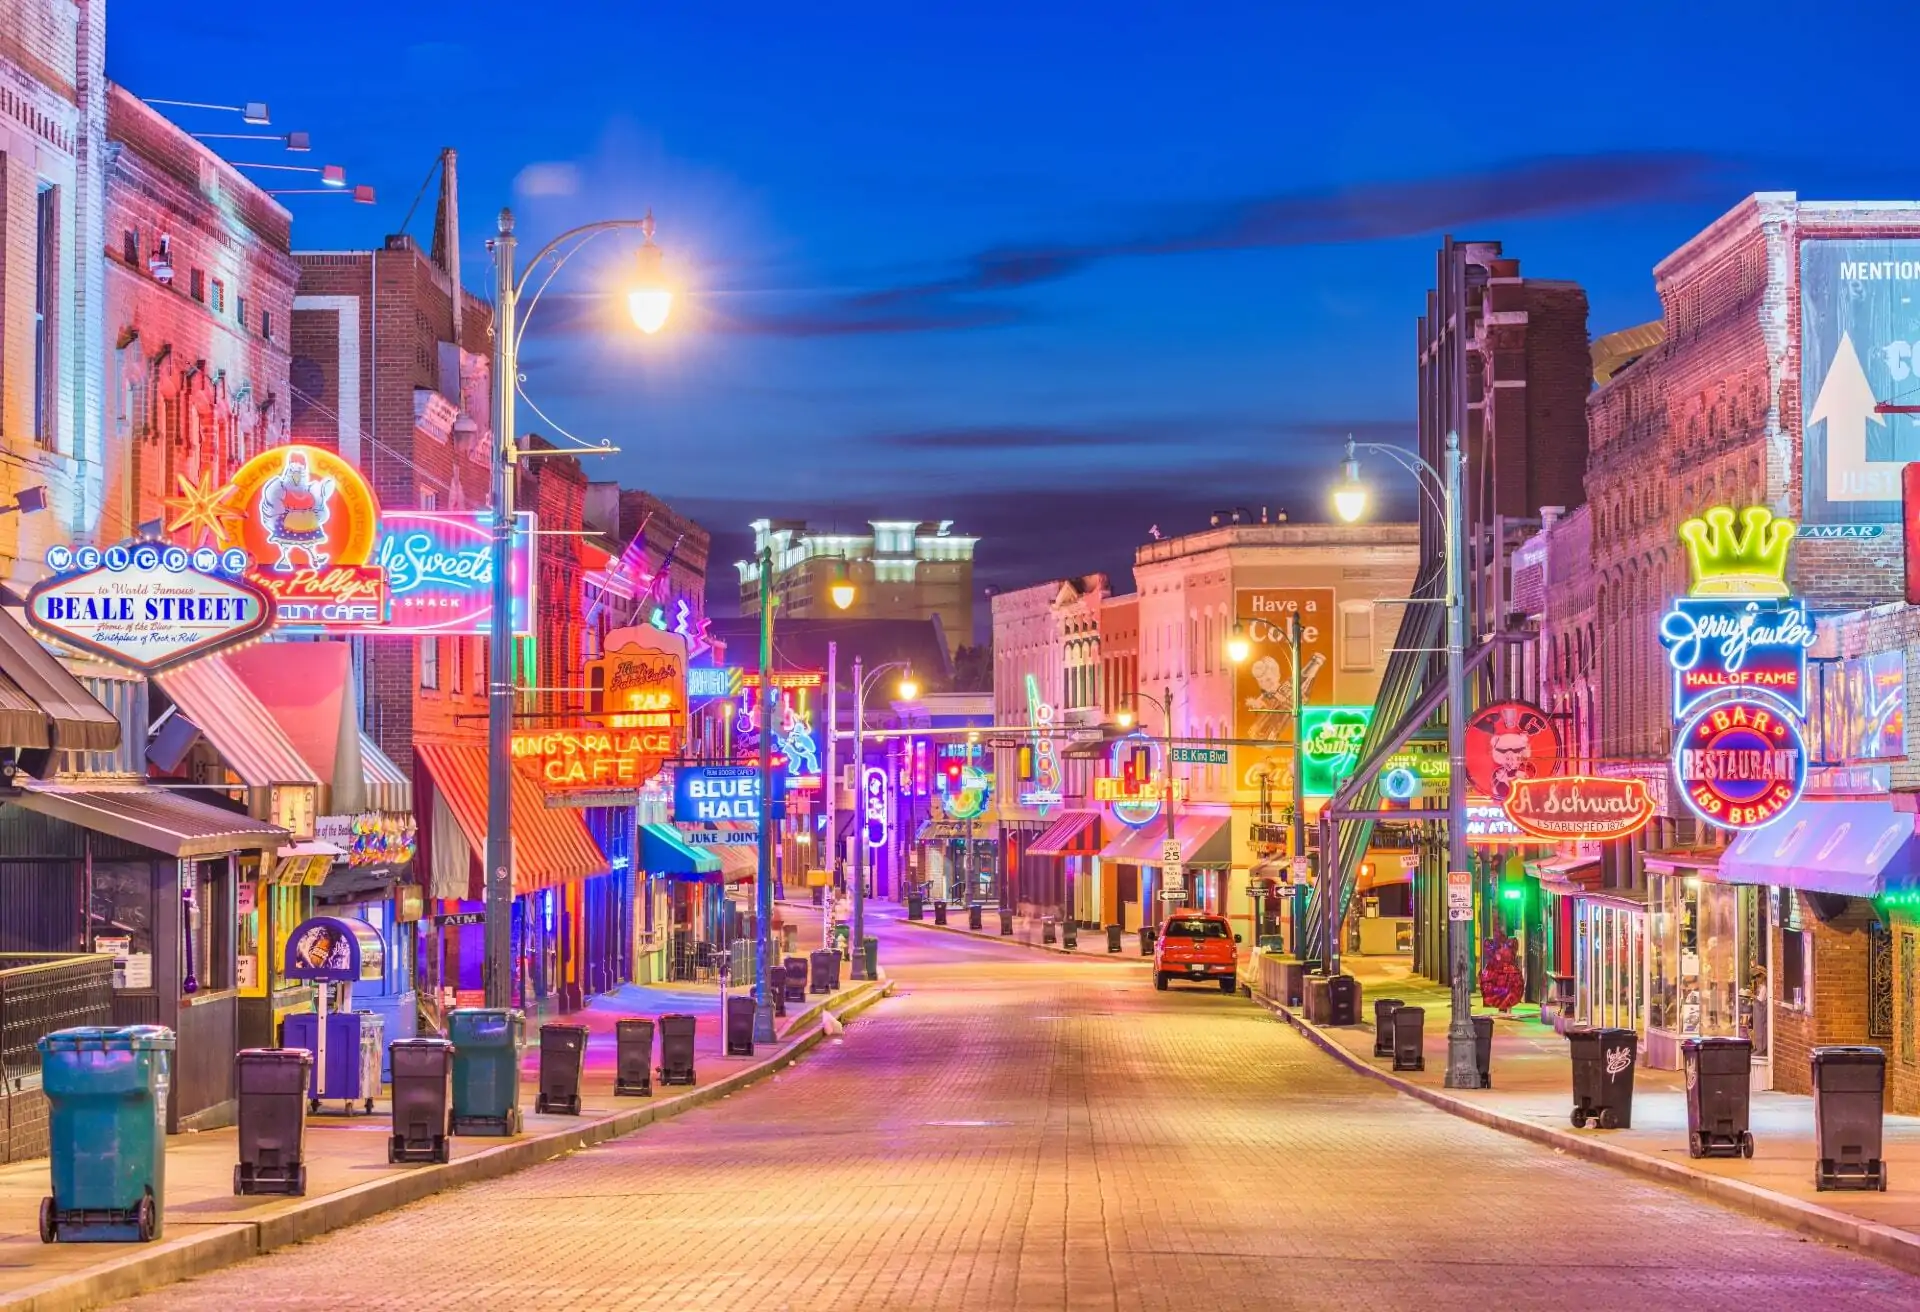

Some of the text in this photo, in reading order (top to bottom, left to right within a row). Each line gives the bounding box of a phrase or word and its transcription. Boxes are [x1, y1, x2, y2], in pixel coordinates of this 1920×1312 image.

[1840, 261, 1920, 280] MENTION
[1840, 471, 1894, 494] JUST
[1797, 526, 1875, 538] LAMAR
[49, 548, 245, 572] WELCOME
[402, 534, 493, 590] Sweets
[98, 583, 196, 595] to World Famous
[287, 569, 379, 603] Polly's
[46, 597, 249, 622] BEALE STREET
[404, 598, 460, 607] SHACK
[1252, 596, 1317, 612] Have a
[276, 604, 377, 620] CITY CAFE
[96, 622, 125, 632] Home
[126, 623, 135, 633] of
[135, 621, 149, 631] the
[93, 632, 138, 645] Birthplace
[140, 633, 148, 645] of
[149, 632, 170, 643] Rock
[178, 632, 200, 643] Roll
[1661, 610, 1742, 670] Jerry
[1686, 671, 1798, 686] HALL OF FAME
[629, 692, 672, 711] TAP
[1712, 705, 1770, 732] BAR
[512, 733, 671, 757] KING'S PALACE
[1191, 751, 1208, 763] King
[1683, 748, 1800, 782] RESTAURANT
[545, 759, 635, 782] CAFE
[690, 779, 760, 797] BLUES
[1512, 785, 1541, 813] A.
[1544, 783, 1644, 814] Schwab
[1691, 785, 1722, 814] 159
[1728, 784, 1793, 824] BEALE
[698, 800, 760, 818] HALL
[1537, 819, 1625, 832] ESTABLISHED 1876
[689, 832, 758, 843] JUKE JOINT
[1164, 851, 1180, 861] 25
[1452, 874, 1467, 882] NO
[444, 914, 477, 925] ATM
